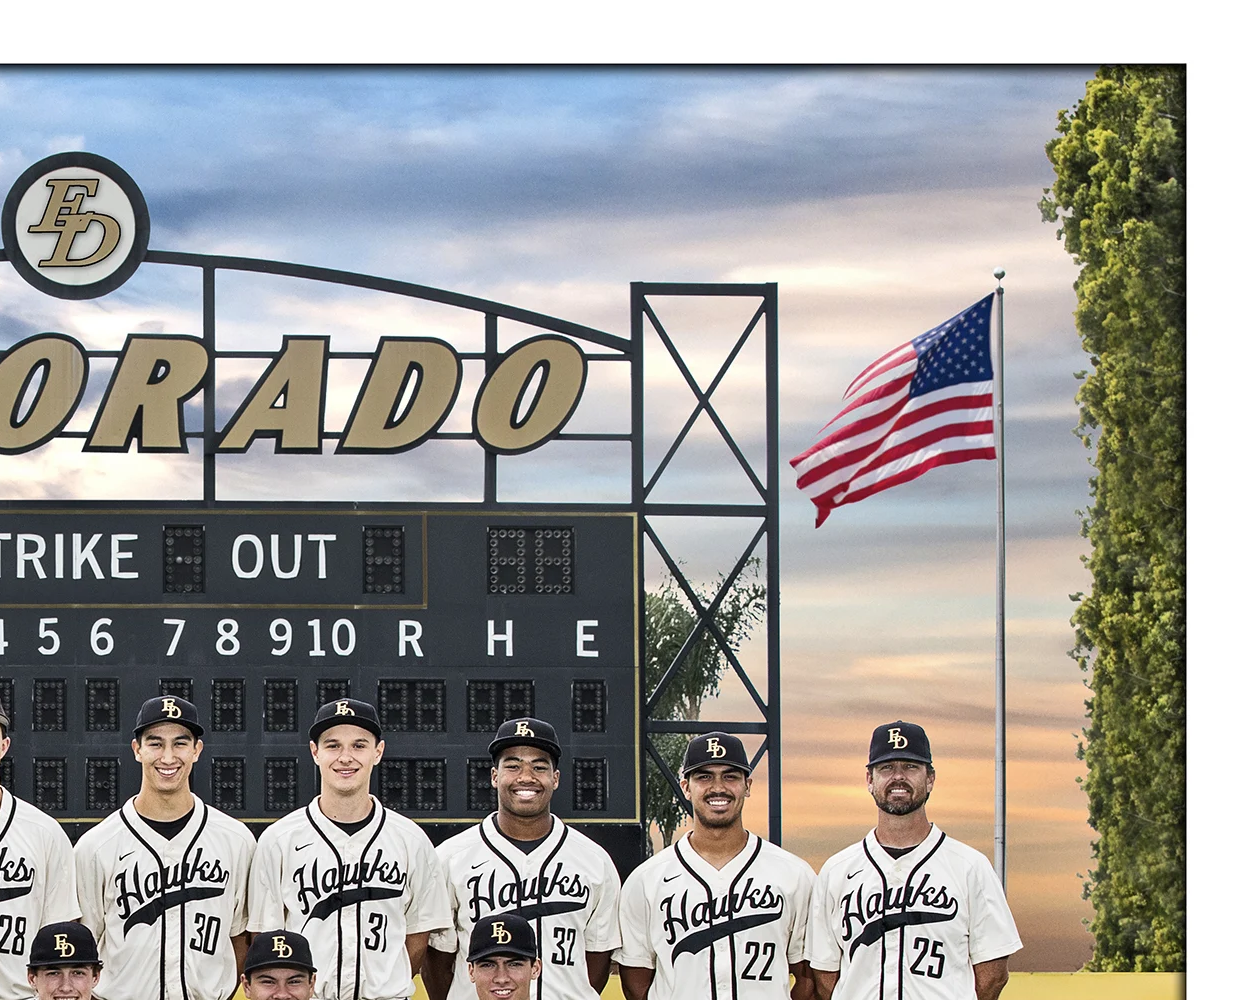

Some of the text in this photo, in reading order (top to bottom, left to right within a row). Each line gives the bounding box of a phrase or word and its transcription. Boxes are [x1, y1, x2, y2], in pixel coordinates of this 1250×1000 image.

[28, 177, 121, 269] ED
[231, 533, 337, 579] OUT
[37, 617, 61, 656] 5
[90, 617, 115, 656] 6
[163, 618, 186, 656] 7
[215, 618, 241, 656] 8
[269, 618, 293, 656] 9
[308, 618, 356, 656] 10
[398, 620, 424, 657] R
[487, 619, 514, 657] H
[576, 619, 599, 657] E
[115, 848, 228, 919] Hawks
[293, 849, 405, 914] Hawks
[467, 862, 589, 922] Hawks
[841, 874, 957, 941] Hawks
[191, 913, 220, 956] 30
[660, 878, 783, 945] Hawks
[551, 926, 576, 967] 32
[741, 941, 776, 981] 22
[910, 937, 945, 979] 25
